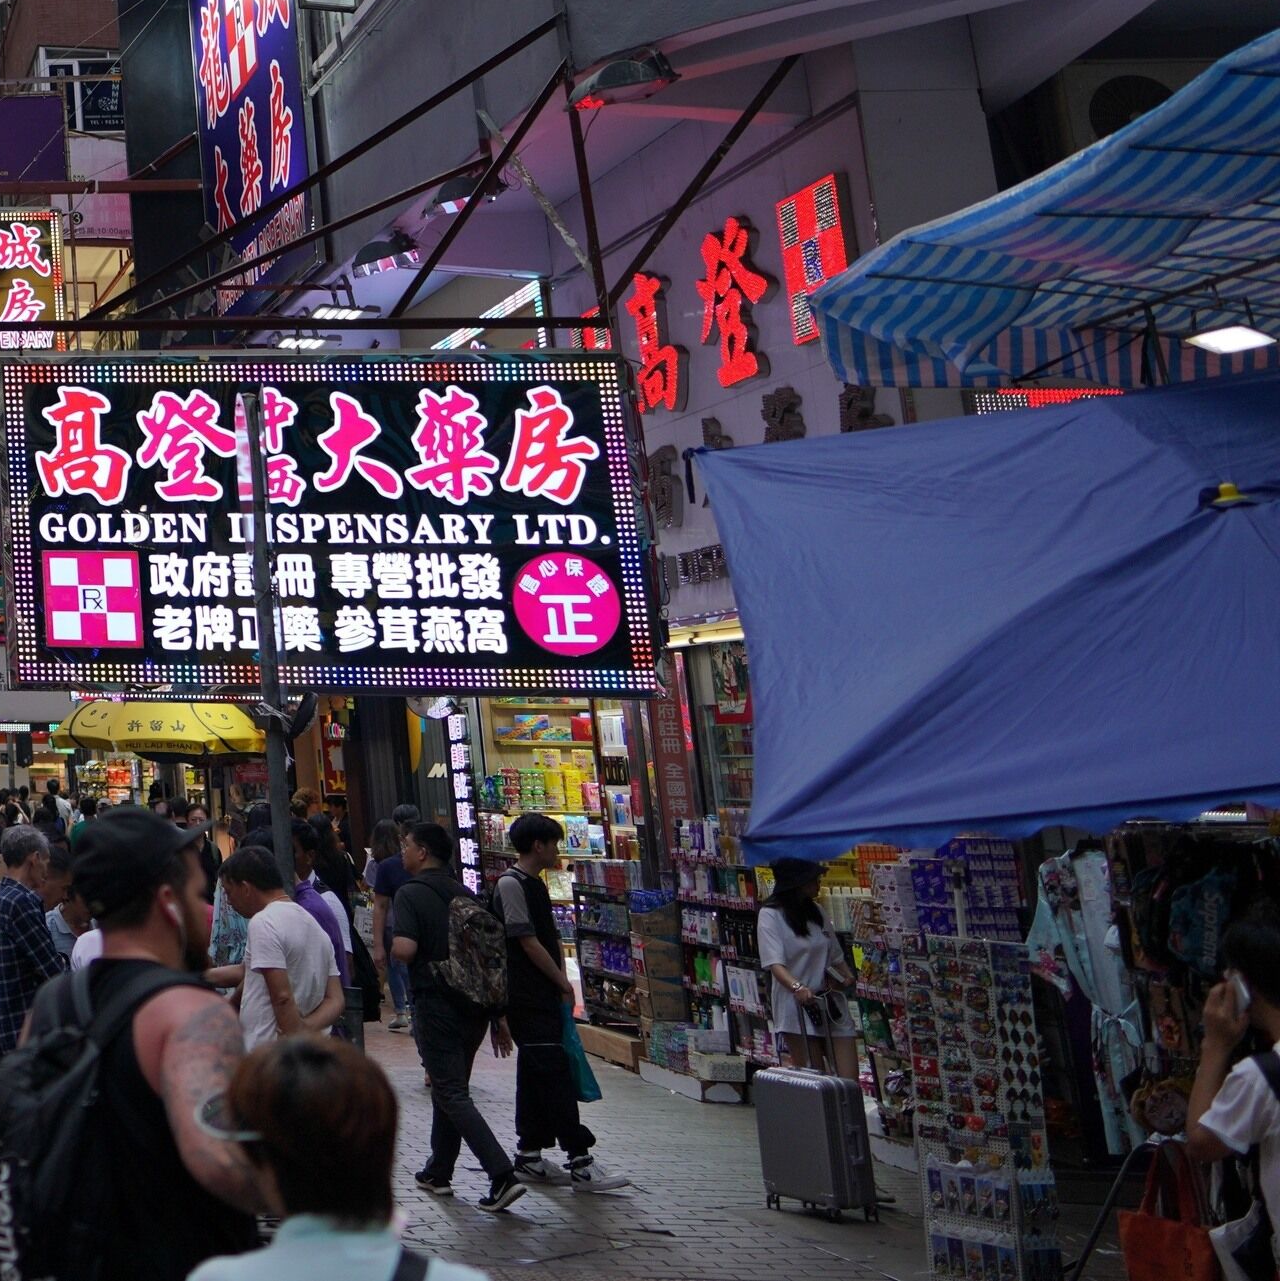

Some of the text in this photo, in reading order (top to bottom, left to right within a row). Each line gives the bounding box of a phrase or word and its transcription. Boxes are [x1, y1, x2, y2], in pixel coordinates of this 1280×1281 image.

[39, 513, 612, 545] GOLDEN LTD.
[330, 552, 505, 601] 專營批發
[334, 606, 509, 654] 參茸燕窩
[540, 595, 599, 645] 正
[127, 719, 187, 734] 許留山
[145, 741, 164, 750] LAU
[166, 740, 193, 751] SHAN
[1200, 889, 1224, 967] Supreme
